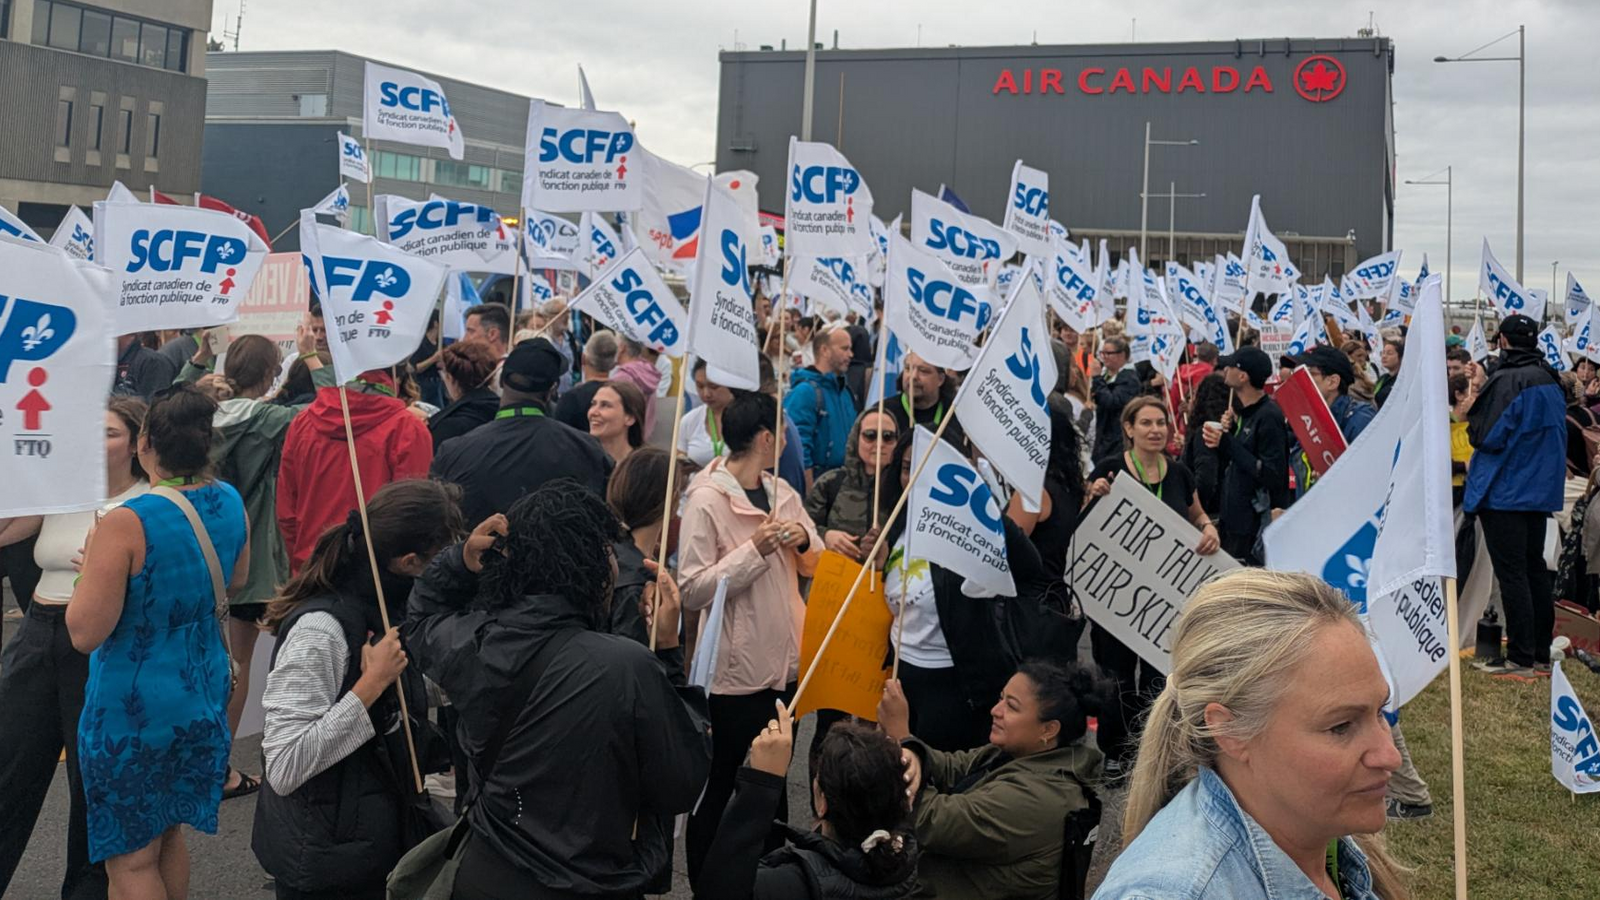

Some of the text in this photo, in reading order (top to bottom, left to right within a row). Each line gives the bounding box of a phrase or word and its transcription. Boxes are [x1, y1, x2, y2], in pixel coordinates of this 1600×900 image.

[993, 66, 1274, 94] AIR CANADA
[538, 127, 634, 164] SCFP
[791, 163, 860, 204] SCFP
[126, 229, 247, 274] SCFP
[427, 231, 474, 245] canadien
[477, 229, 490, 238] de
[441, 241, 487, 255] publique
[926, 218, 1001, 261] SCFP
[127, 292, 158, 306] fonction
[159, 291, 203, 306] publique
[153, 277, 193, 291] canadien
[195, 280, 212, 292] de
[906, 267, 992, 332] SCFP
[347, 310, 364, 325] de
[611, 268, 679, 347] SCFP
[715, 290, 745, 318] Syndicat
[368, 328, 391, 338] FTQ
[711, 308, 749, 341] la fonction
[928, 322, 971, 342] canadien
[976, 382, 986, 397] la
[983, 393, 1011, 432] fonction
[985, 368, 1051, 451] Syndicat canadien
[1300, 415, 1321, 444] Air
[14, 439, 51, 458] FTQ
[916, 521, 926, 532] la
[929, 523, 980, 557] fonction
[920, 507, 972, 538] Syndicat
[1100, 498, 1164, 562] FAIR
[1065, 542, 1179, 655] FAIR SKIE
[1395, 593, 1446, 663] publique
